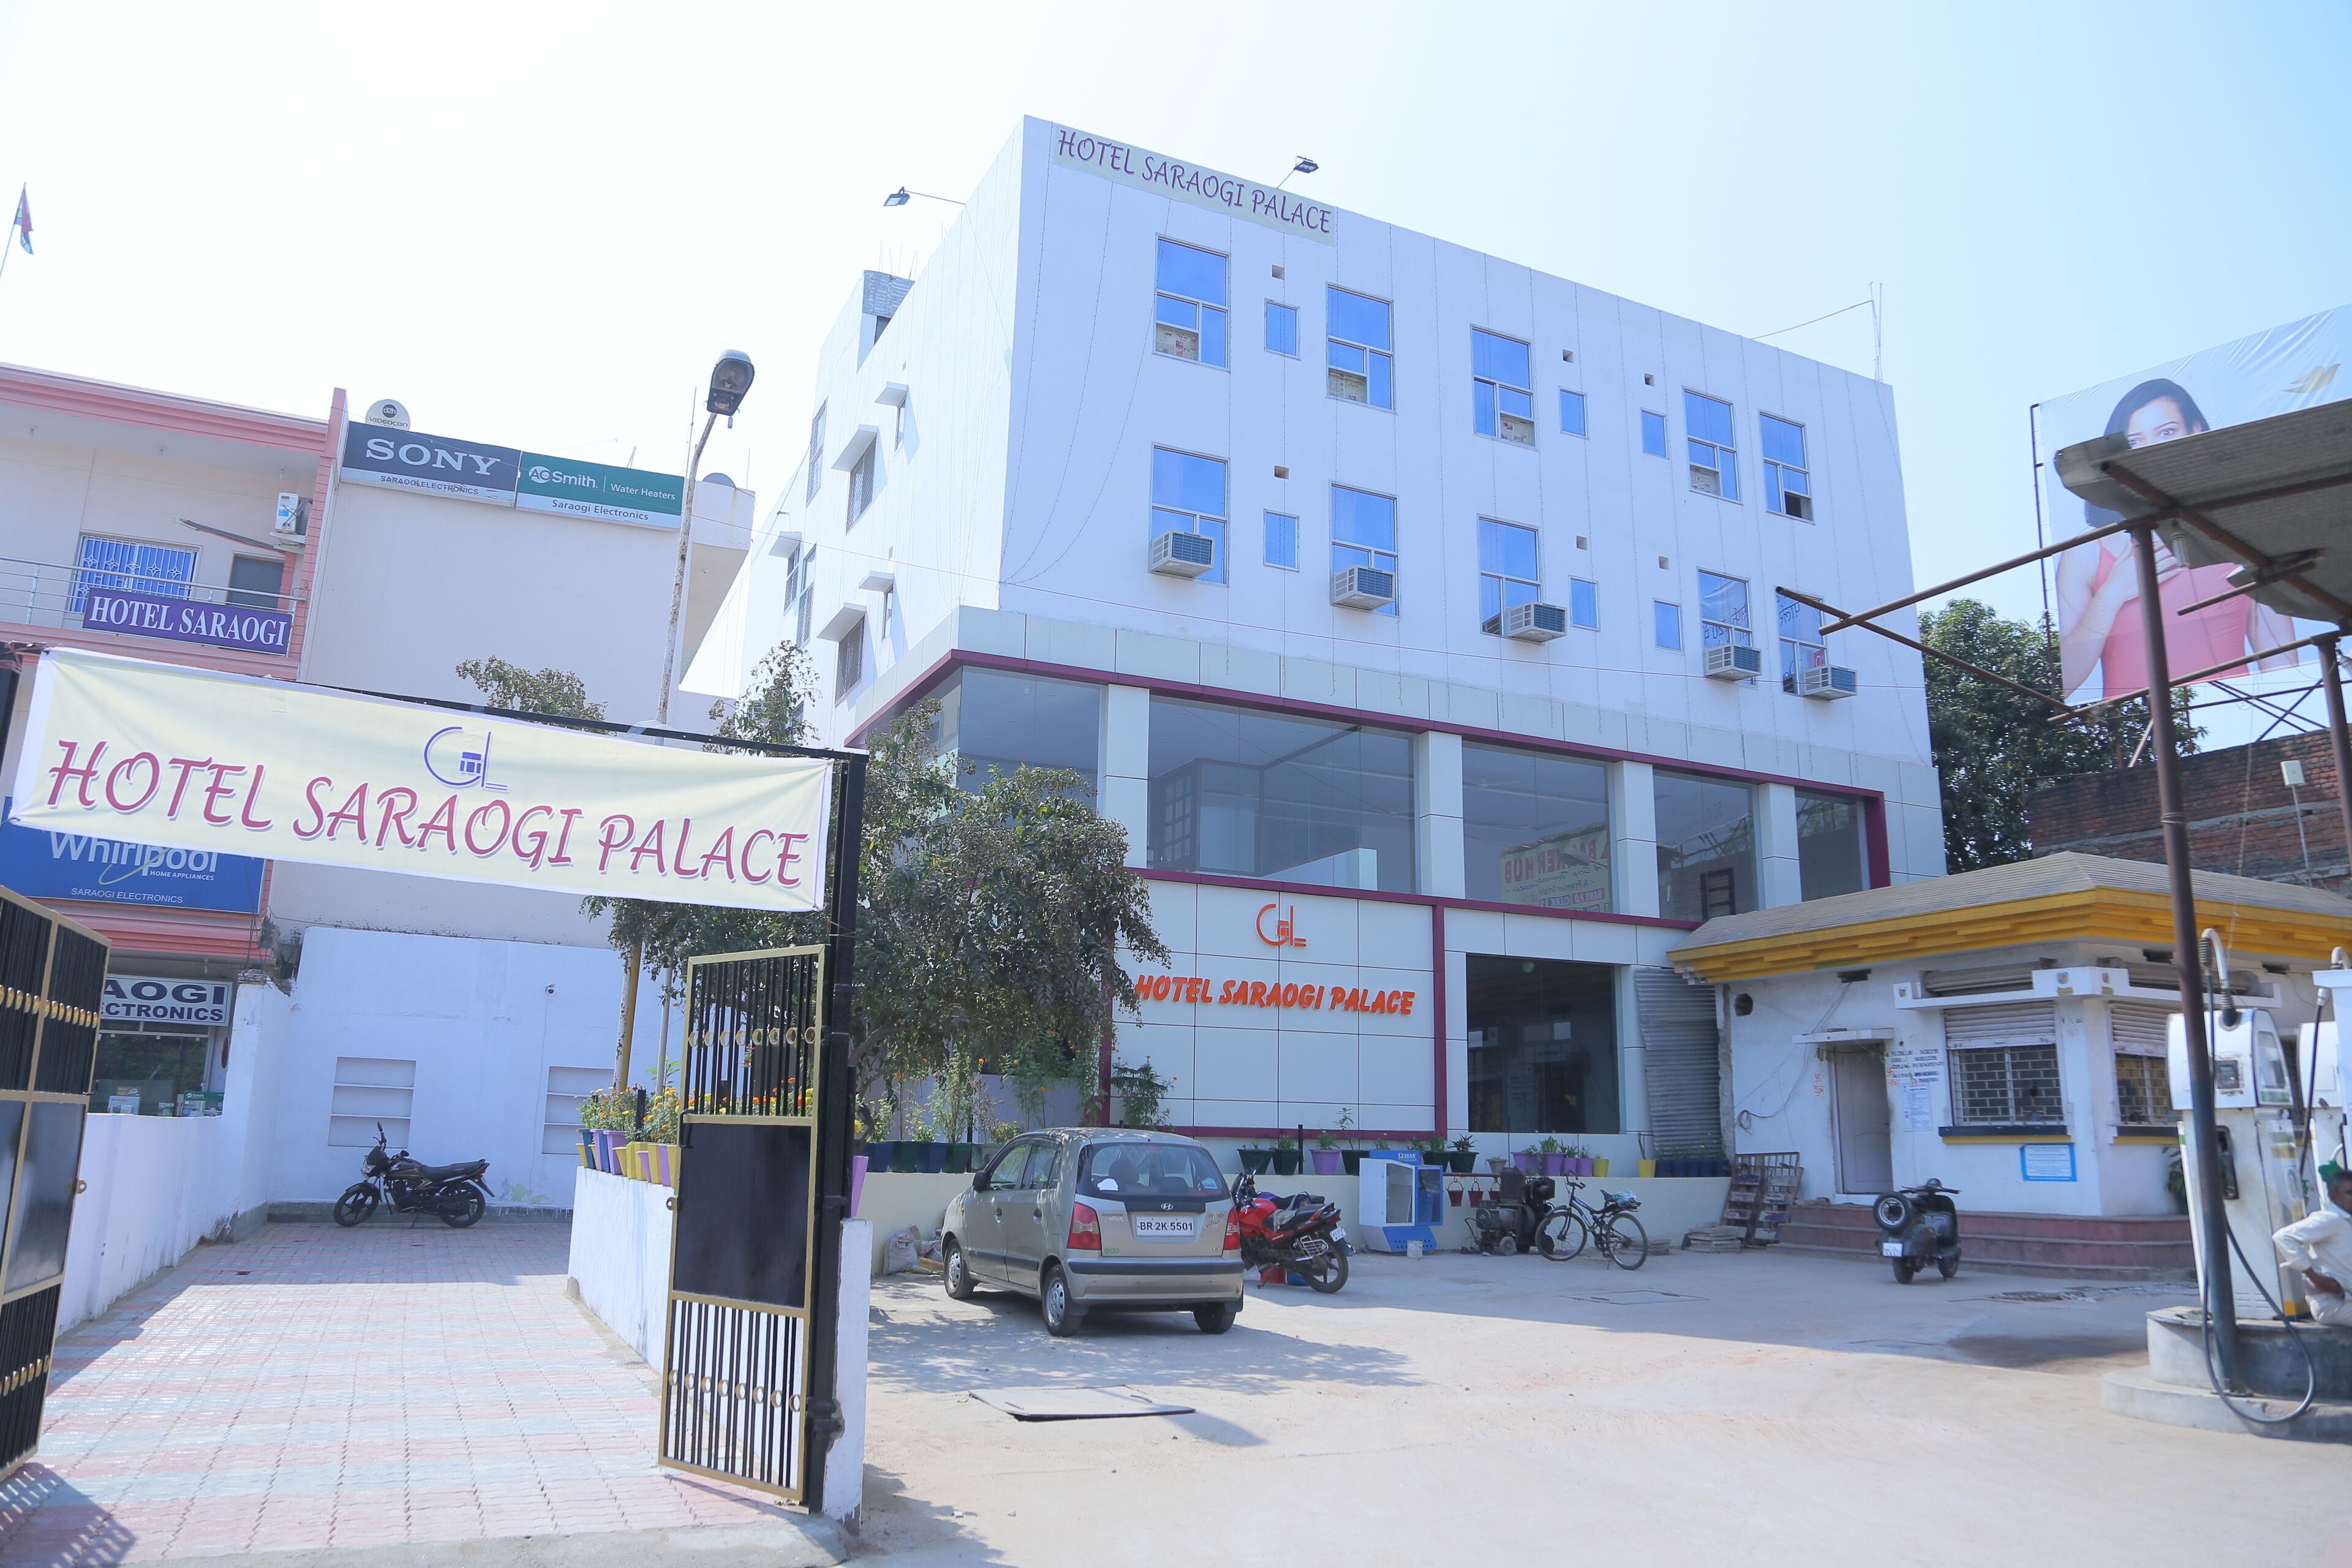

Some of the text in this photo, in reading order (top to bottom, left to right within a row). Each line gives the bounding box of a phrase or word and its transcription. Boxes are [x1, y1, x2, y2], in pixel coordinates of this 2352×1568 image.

[1058, 129, 1332, 234] HOTEL SARAOGI PALACE
[383, 406, 397, 415] d2h
[369, 416, 408, 427] VIDEOCON
[366, 438, 501, 476] SONY
[421, 480, 479, 495] ELECTRONICS
[611, 483, 639, 495] Water
[641, 488, 676, 500] Heaters
[552, 499, 649, 521] Saraogi Electronics
[89, 595, 287, 646] HOTEL SARAOGI
[47, 739, 810, 887] HOTEL SARAOGI PALACE
[50, 831, 219, 876] Whirlpool
[172, 872, 214, 881] APPLIANCES
[70, 888, 184, 903] SARAOGI ELECTRONICS
[1135, 974, 1416, 1015] HOTEL SARAOGI PALACE
[1170, 1221, 1193, 1231] 5501
